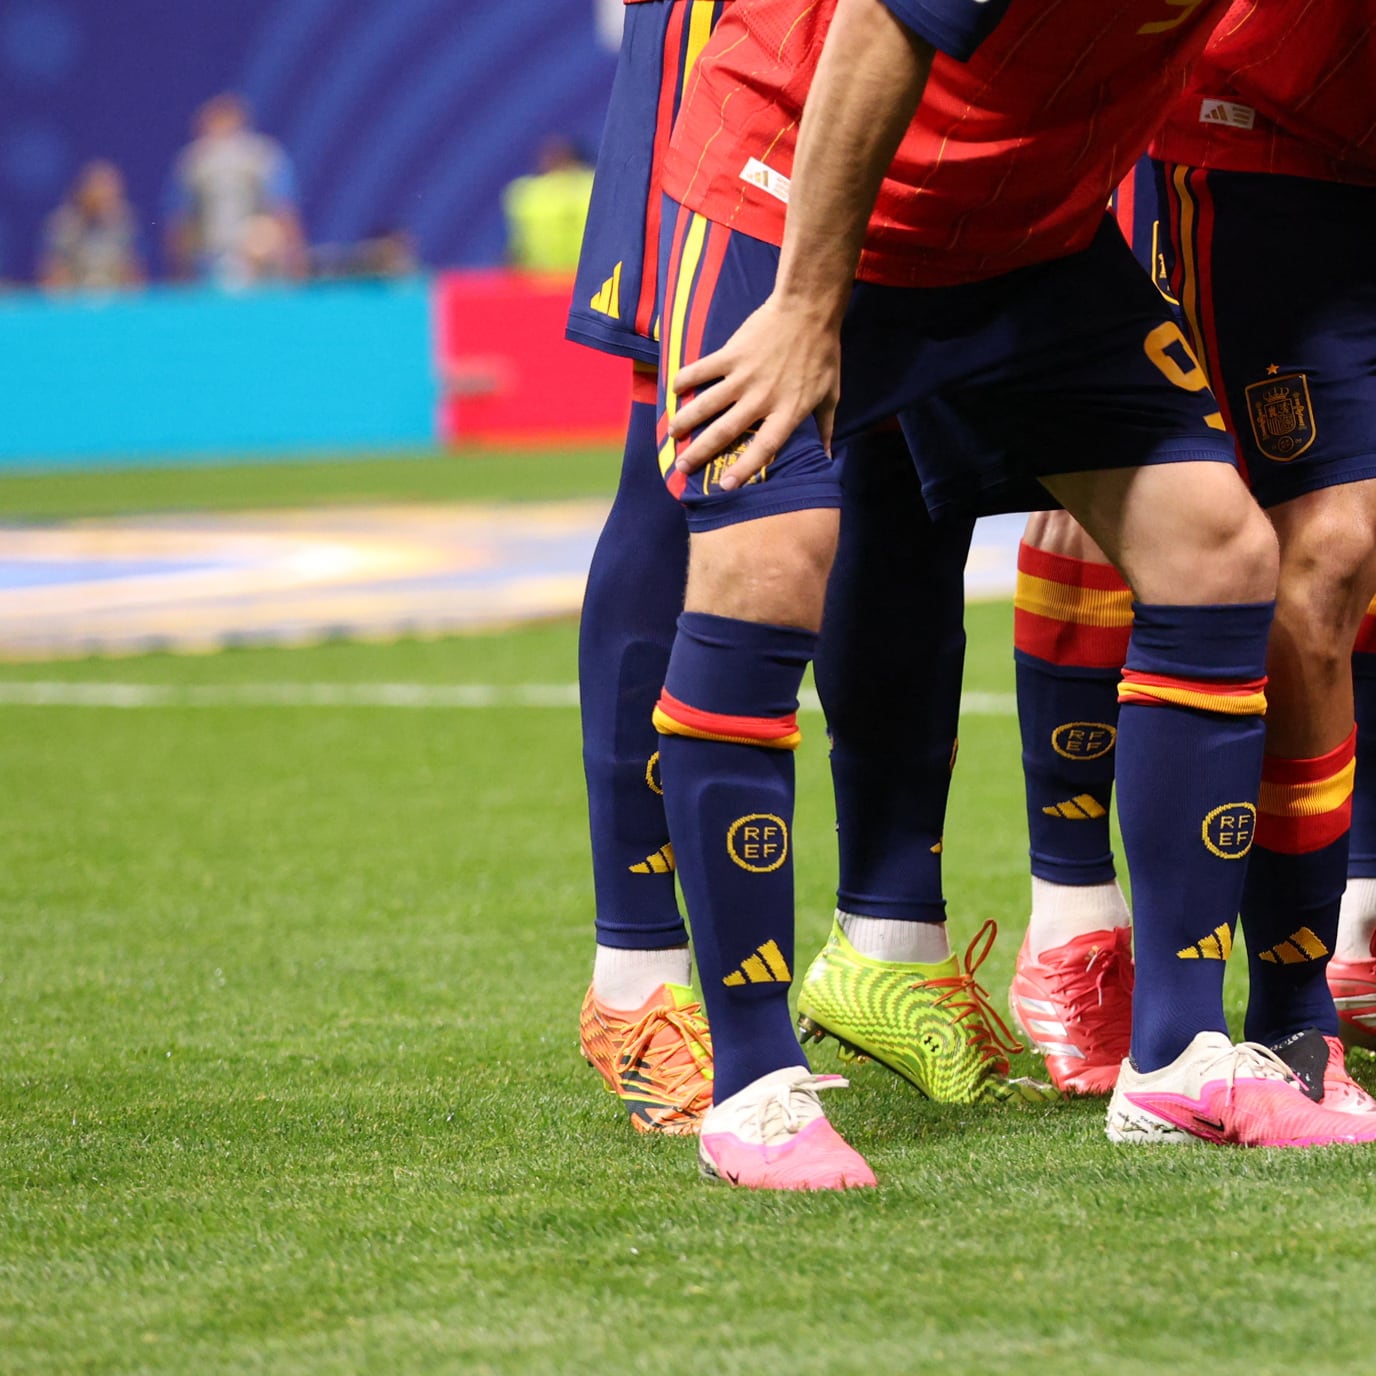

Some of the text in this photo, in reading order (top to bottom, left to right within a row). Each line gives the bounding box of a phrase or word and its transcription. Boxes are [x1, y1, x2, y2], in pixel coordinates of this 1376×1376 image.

[1068, 729, 1105, 741] RF
[1066, 741, 1103, 751] EF
[1220, 814, 1251, 830] RF
[744, 826, 778, 841] RF
[1219, 831, 1249, 846] EF
[744, 843, 778, 859] EF
